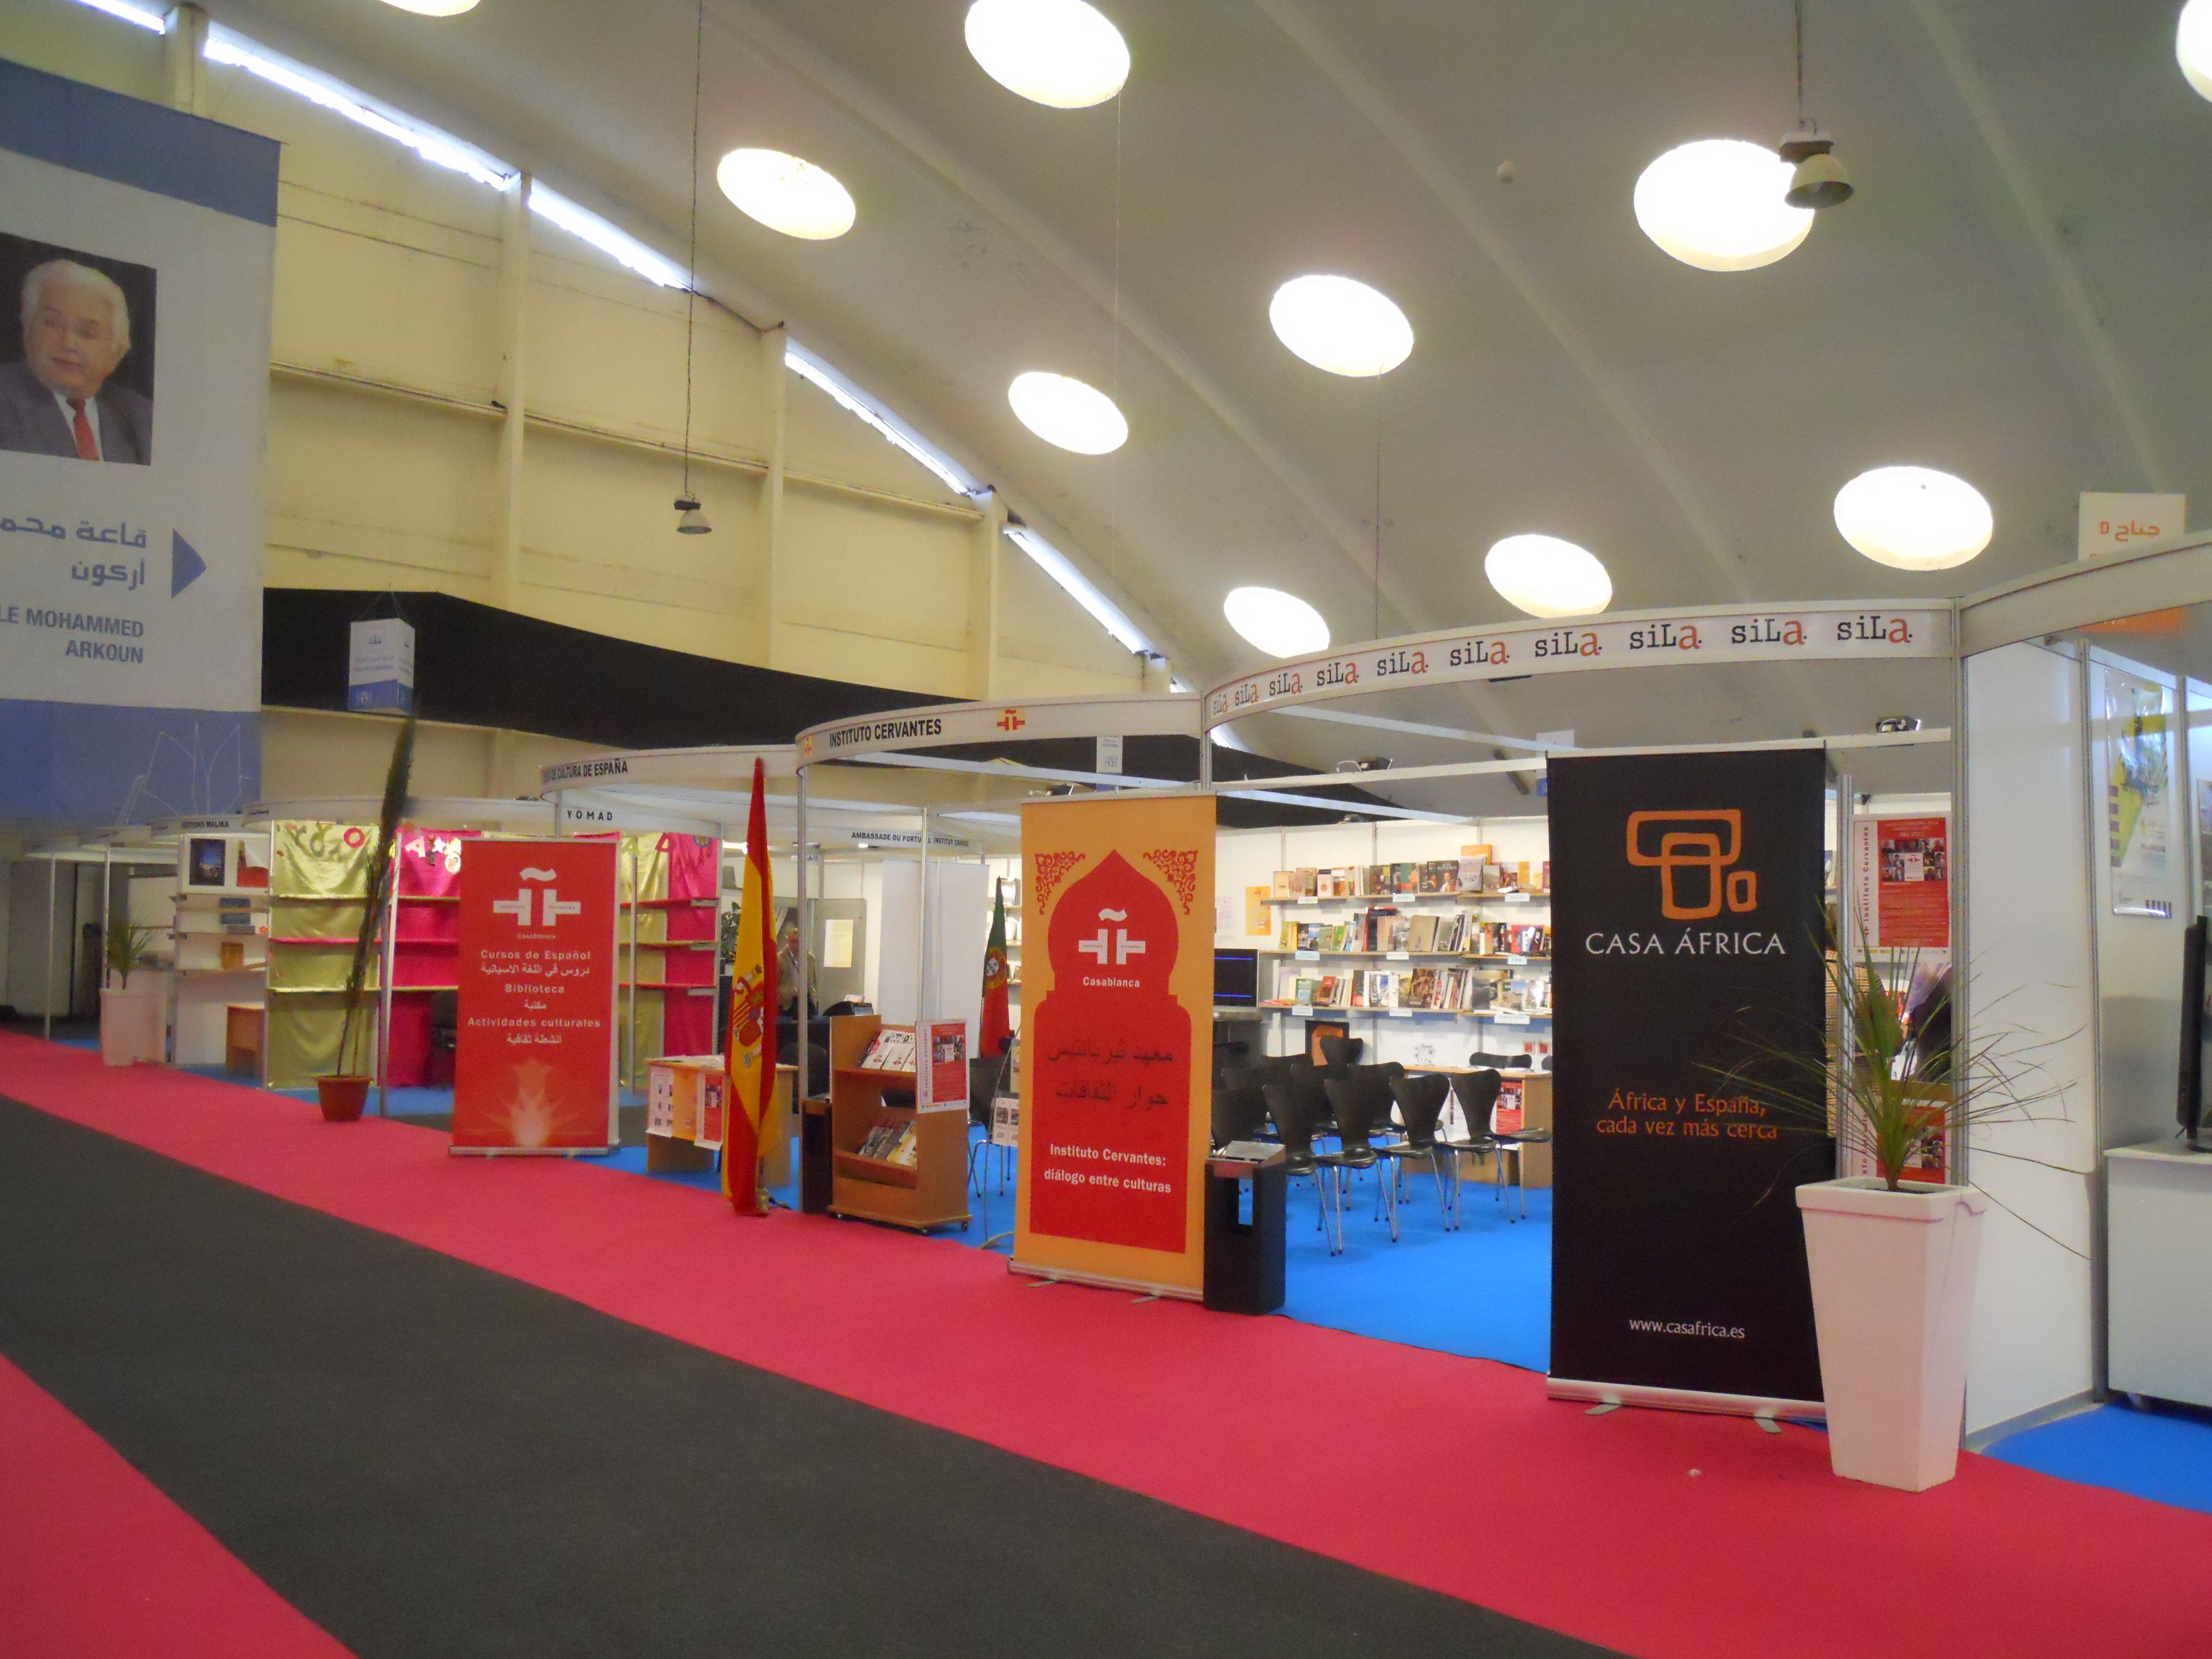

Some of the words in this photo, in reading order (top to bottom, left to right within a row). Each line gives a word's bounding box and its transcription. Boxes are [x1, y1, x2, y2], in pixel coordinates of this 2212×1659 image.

[76, 520, 147, 548] قاعة
[2100, 521, 2110, 535] D
[26, 608, 144, 638] MOHAMMED
[65, 639, 144, 664] ARKOUN
[830, 726, 871, 748] INSTITUTO
[874, 718, 942, 740] CERVANTES
[557, 765, 582, 779] CULTURA
[583, 764, 592, 776] DE
[594, 758, 628, 776] ESPAÑA
[567, 810, 613, 821] YOMAD
[852, 832, 891, 841] AMBASSADE
[902, 835, 931, 843] PORTUL
[933, 837, 953, 845] INSTITUT
[1585, 933, 1665, 954] CASA
[1674, 927, 1786, 955] ÁFRICA
[481, 950, 520, 959] Cursos
[525, 950, 540, 959] de
[545, 950, 591, 961] Español
[545, 963, 558, 977] في
[505, 984, 565, 993] Biblioteca
[1082, 976, 1141, 988] Casablanca
[467, 1017, 536, 1027] Actividades
[541, 1018, 601, 1027] culturales
[1608, 1088, 1667, 1112] África
[1676, 1097, 1686, 1115] y
[1694, 1093, 1767, 1117] España,
[1597, 1115, 1637, 1134] cada
[1646, 1120, 1674, 1135] vez
[1684, 1118, 1719, 1137] más
[1727, 1123, 1780, 1140] cerca
[1050, 1144, 1099, 1159] Instituto
[1103, 1148, 1166, 1166] Cervantes:
[1044, 1168, 1086, 1185] diálogo
[1089, 1175, 1119, 1187] entre
[1123, 1178, 1172, 1193] culturas
[1629, 1319, 1746, 1339] www.casafrica.es
